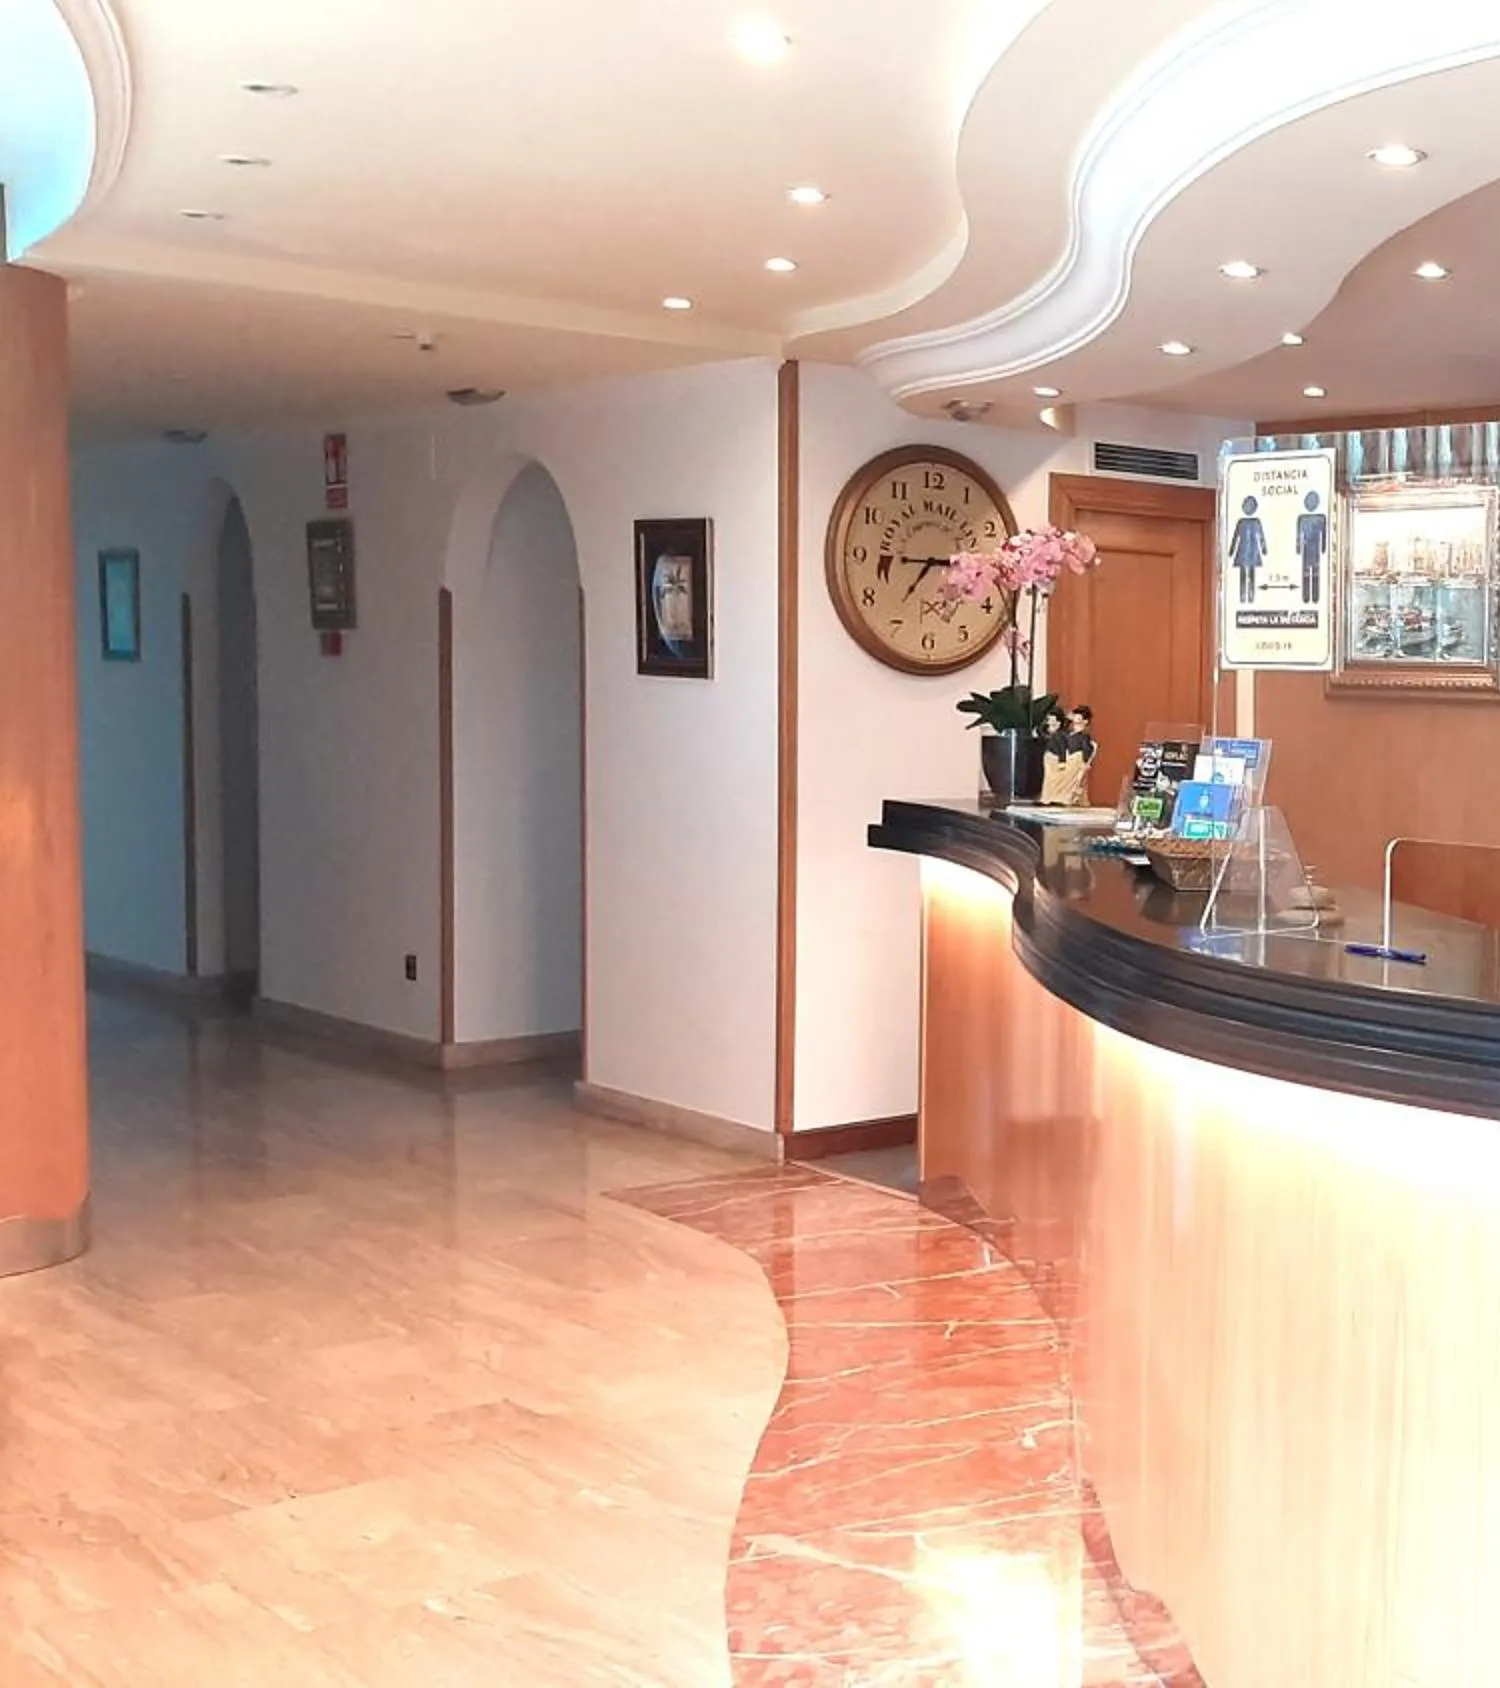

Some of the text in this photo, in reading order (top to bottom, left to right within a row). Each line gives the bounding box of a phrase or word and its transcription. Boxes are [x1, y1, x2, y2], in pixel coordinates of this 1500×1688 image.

[924, 471, 945, 491] 12
[1253, 469, 1309, 481] DISTANCIA
[891, 482, 908, 501] 11
[964, 487, 971, 505] 1
[1261, 485, 1299, 496] SOCIAL
[865, 507, 885, 526] 10
[879, 504, 915, 551] ROYAL
[923, 500, 957, 520] MAIL
[984, 521, 996, 537] 2
[853, 547, 867, 564] 9
[862, 587, 876, 607] 8
[980, 597, 994, 615] 4
[890, 619, 903, 637] 7
[958, 625, 969, 642] 5
[921, 634, 935, 650] 6
